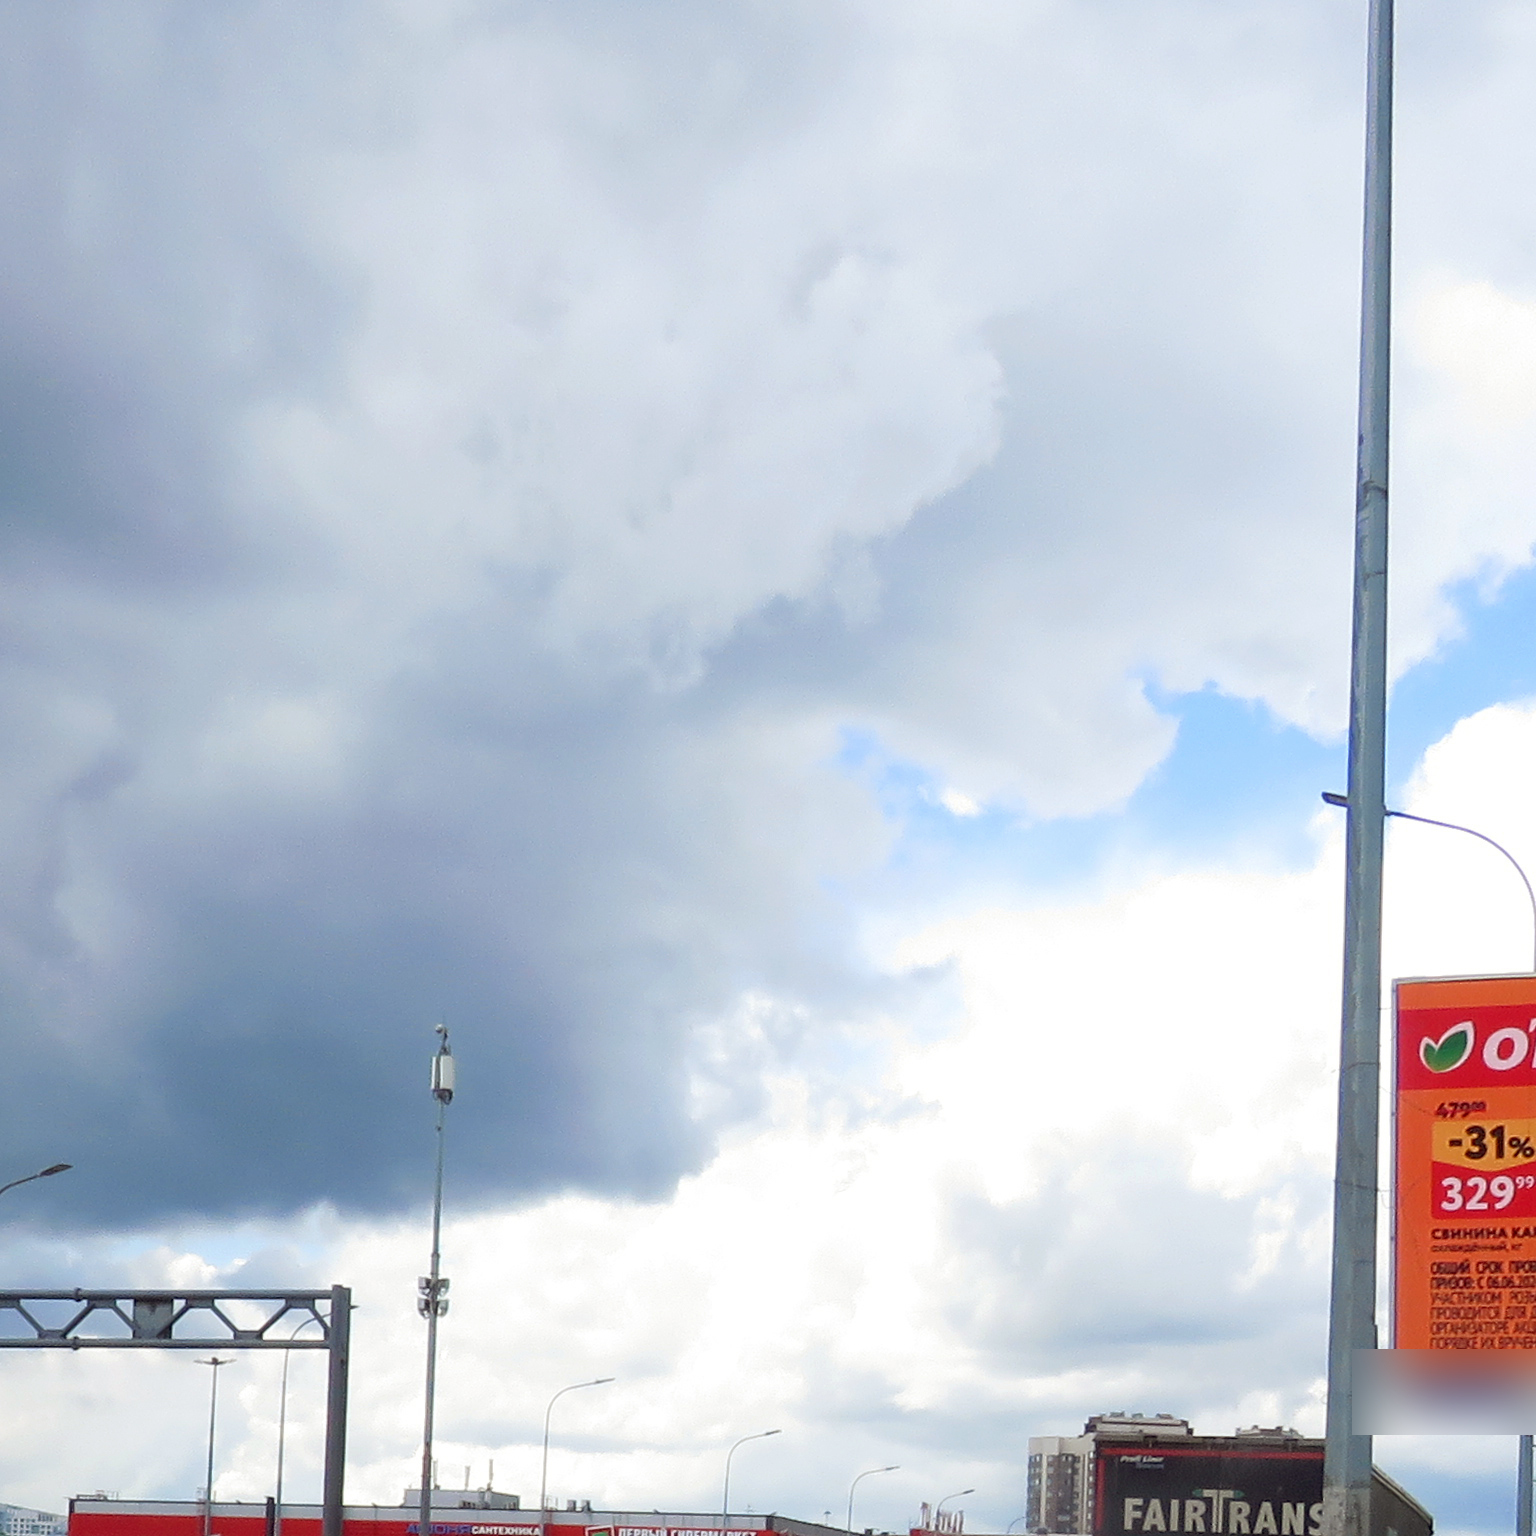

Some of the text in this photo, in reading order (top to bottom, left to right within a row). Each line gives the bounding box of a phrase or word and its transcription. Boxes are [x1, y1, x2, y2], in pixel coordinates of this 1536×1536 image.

[1448, 1125, 1535, 1159] -31%
[1431, 1227, 1507, 1240] СВИНИНА
[1123, 1488, 1324, 1536] FAIRTRANS
[472, 1526, 542, 1536] САНТЕХНИКА
